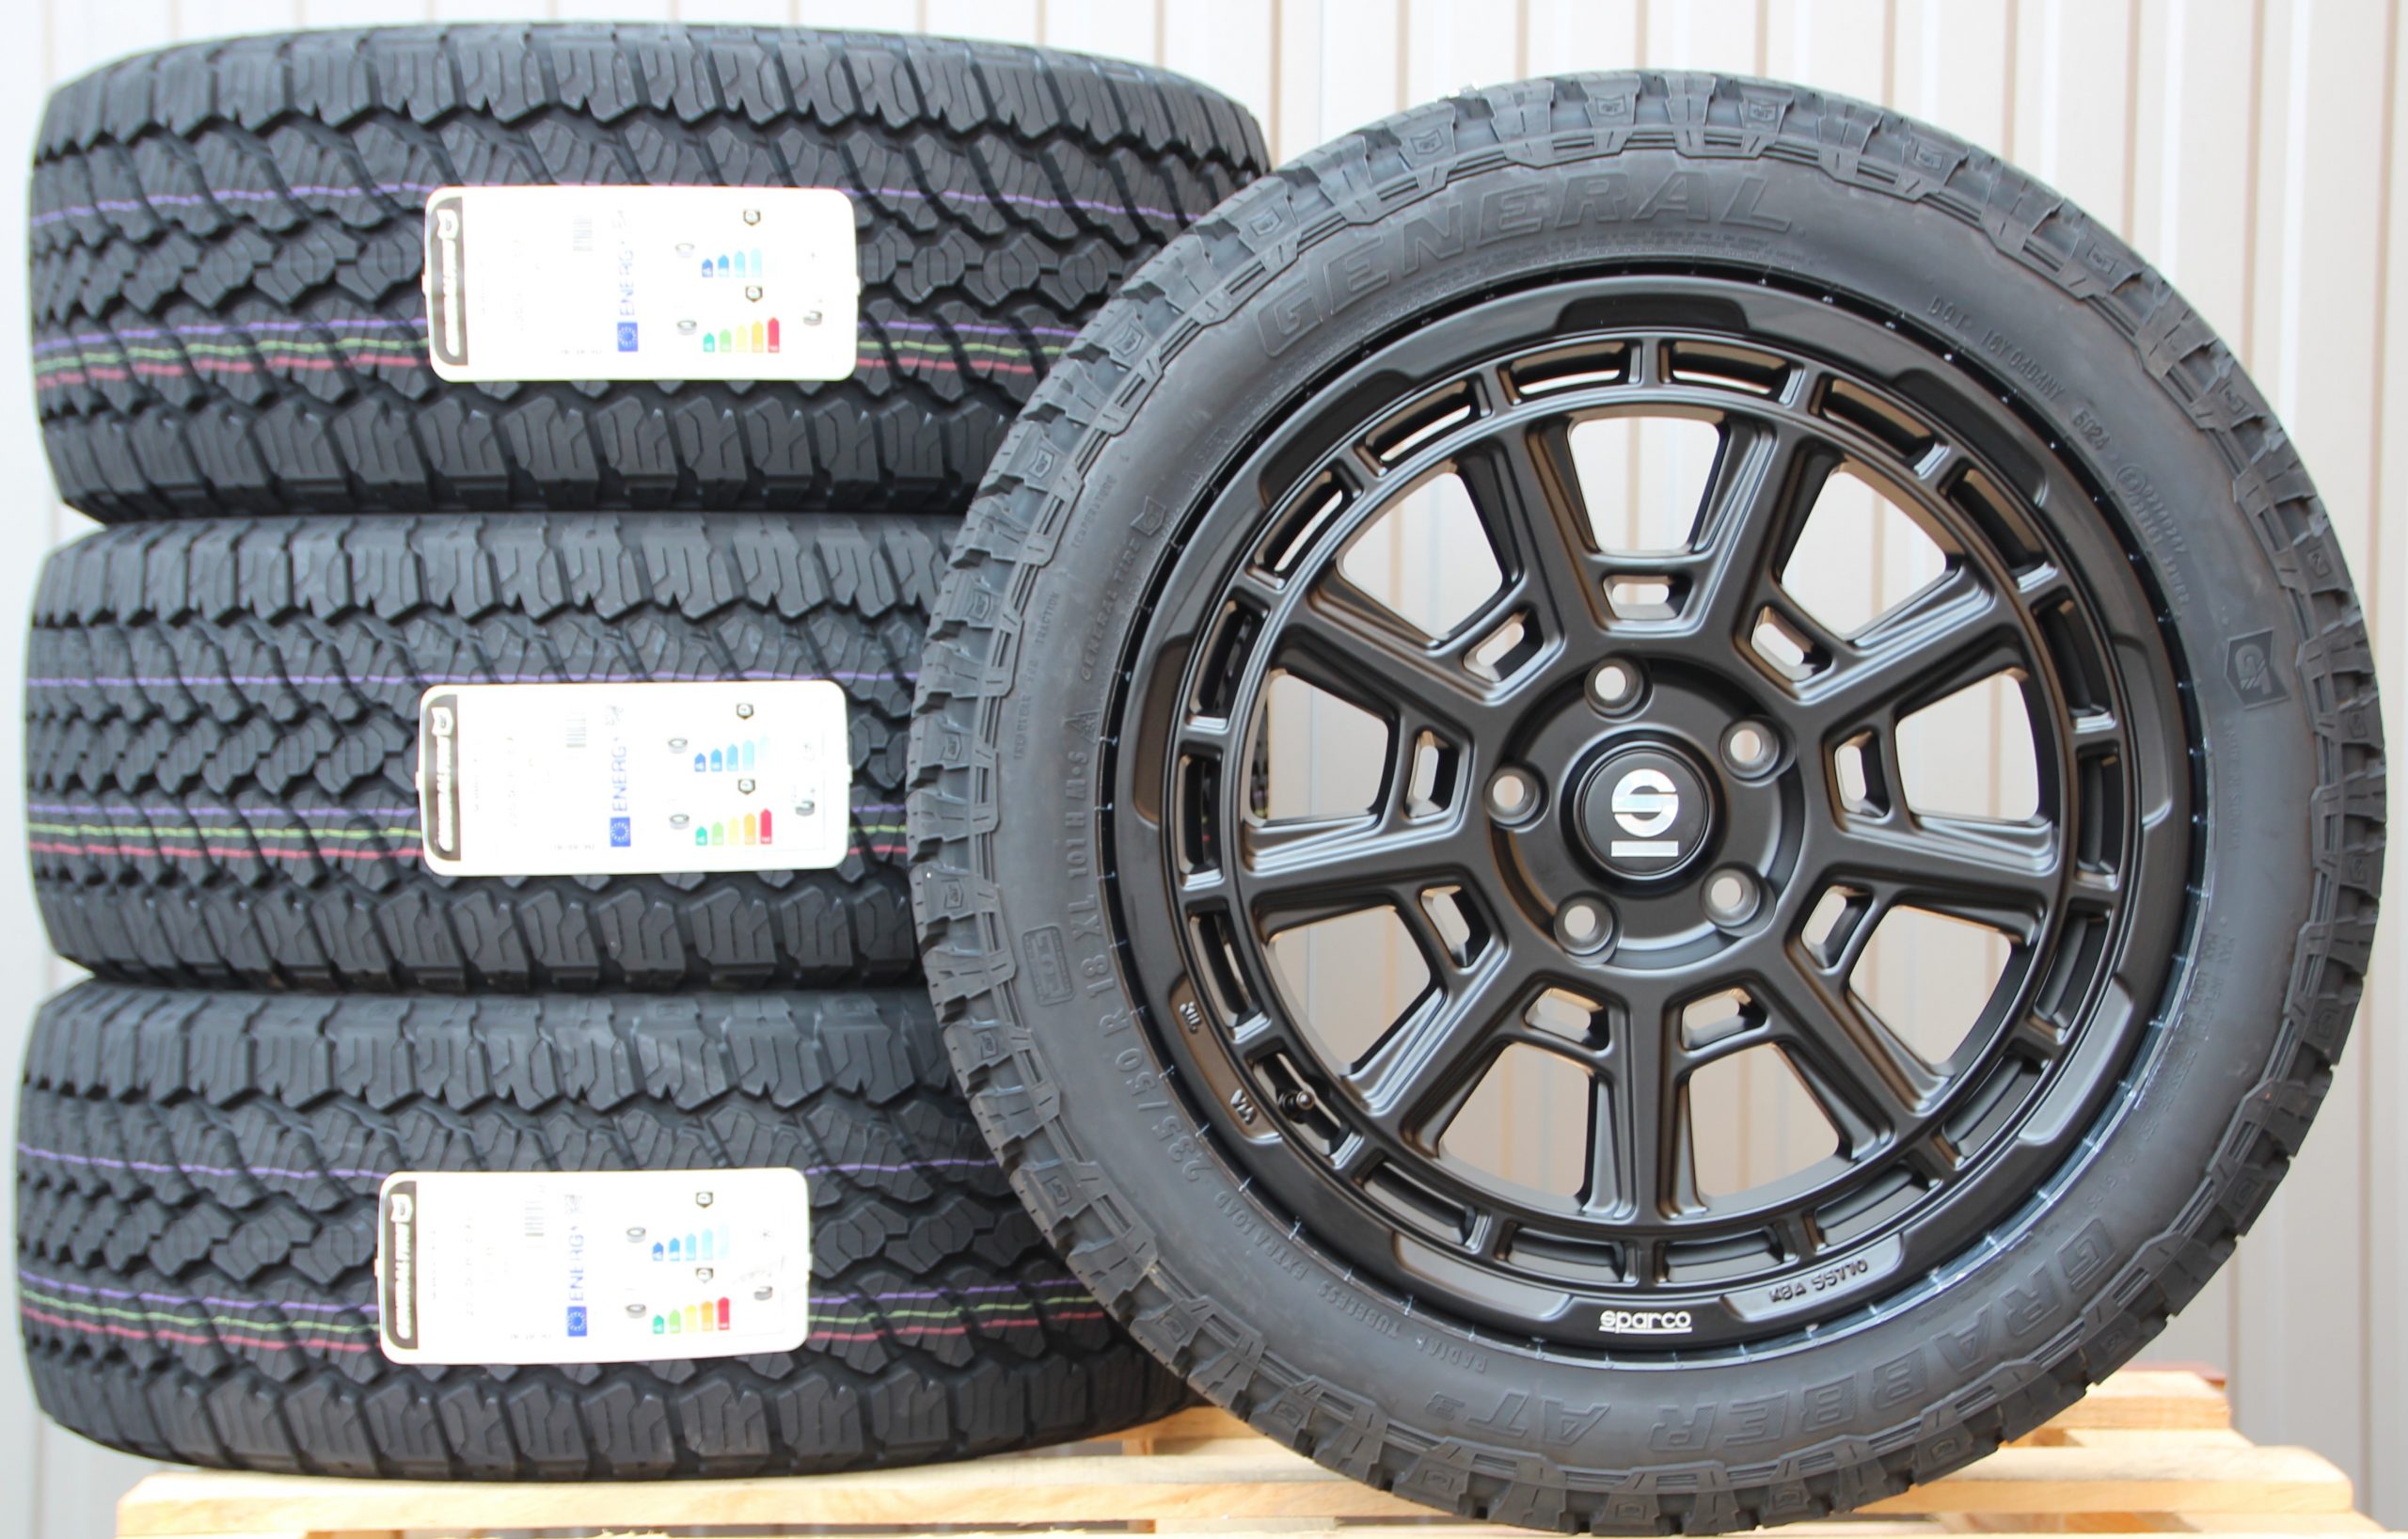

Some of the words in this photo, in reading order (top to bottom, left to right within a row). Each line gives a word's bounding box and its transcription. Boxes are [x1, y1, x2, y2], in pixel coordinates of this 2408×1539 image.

[1247, 171, 1794, 356] GENERAL
[1063, 810, 1085, 827] H
[1064, 836, 1089, 879] 101
[1064, 893, 1102, 942] XL
[1077, 953, 1115, 997] 18
[1099, 1009, 1131, 1038] R
[1115, 1047, 1212, 1183] 235/50
[1212, 1191, 1255, 1233] LOAD
[1253, 1231, 1307, 1278] EXTRA
[1316, 1281, 1399, 1337] TUBELESS
[1599, 1309, 1693, 1334] sparco
[1650, 1219, 2115, 1452] GRABBER
